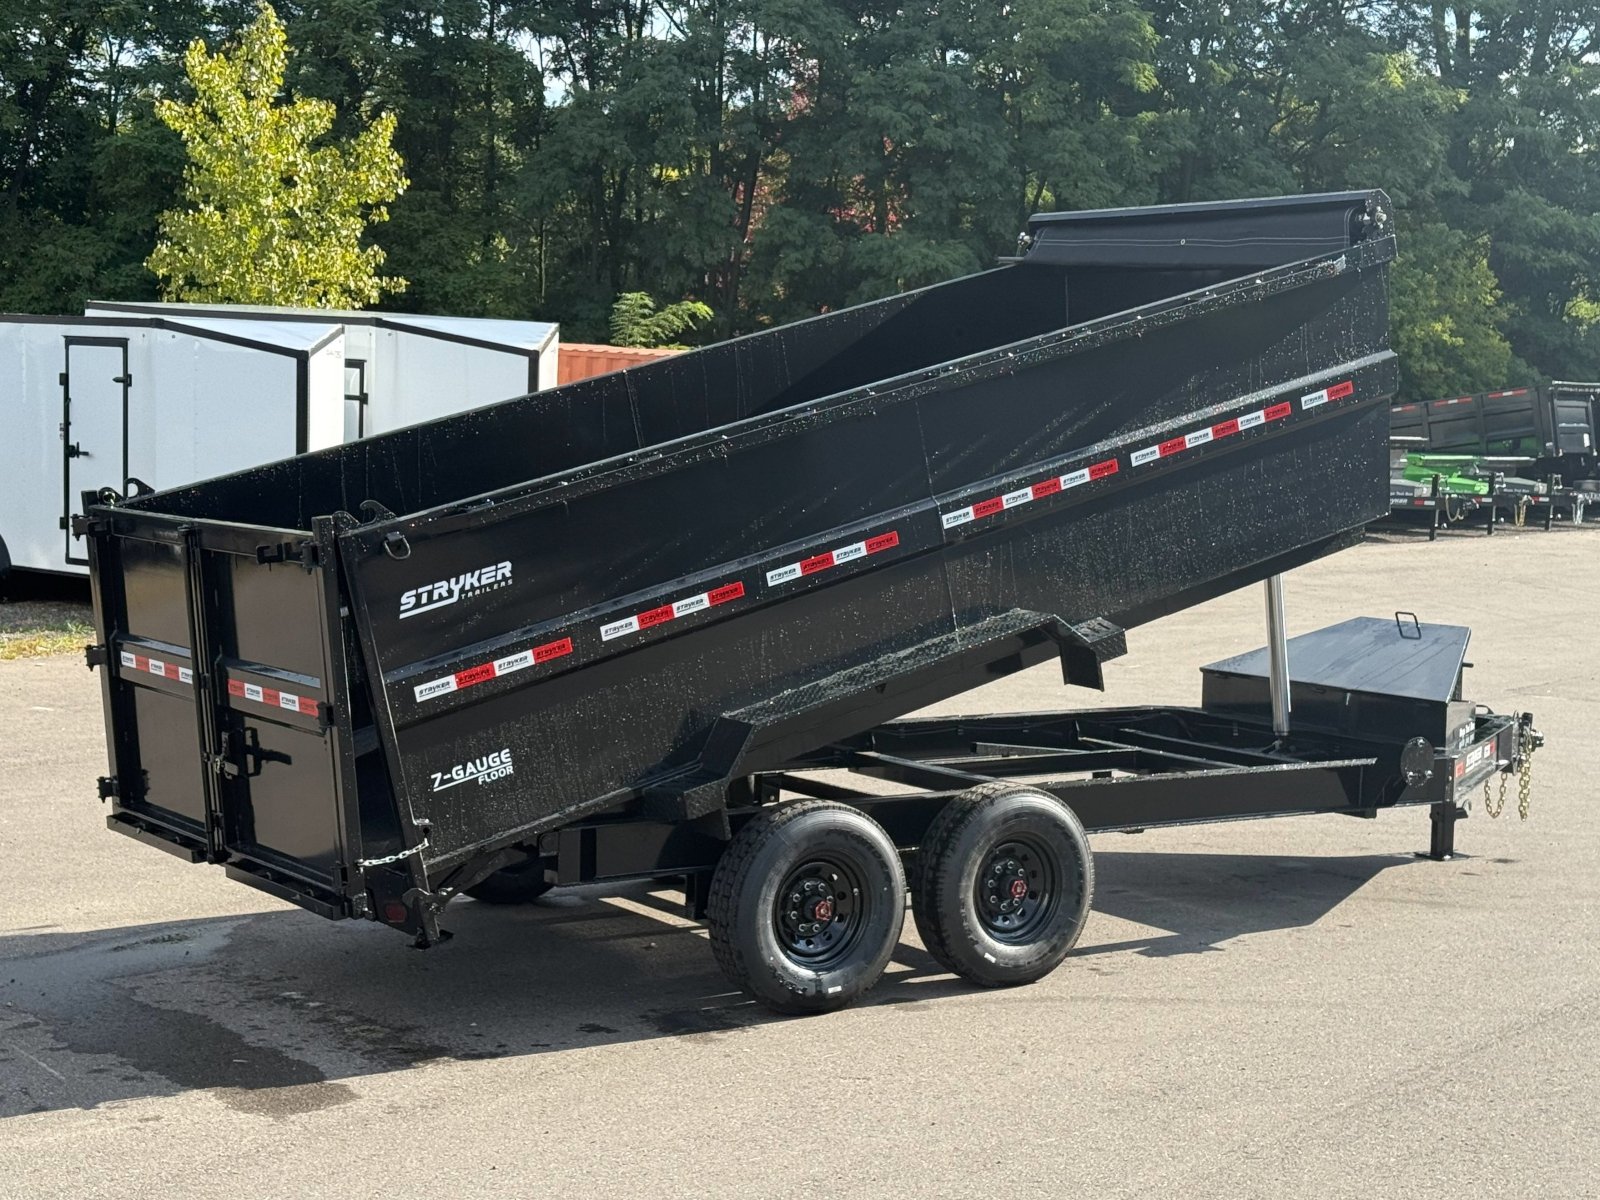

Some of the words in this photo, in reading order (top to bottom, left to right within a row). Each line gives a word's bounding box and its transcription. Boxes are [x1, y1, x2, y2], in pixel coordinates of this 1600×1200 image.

[400, 560, 513, 618] STRYKER
[461, 579, 513, 599] TRAILERS
[604, 622, 634, 636] STRYKER
[676, 599, 704, 612] STRYKER
[419, 681, 450, 697] STRYKER
[498, 656, 528, 670] STRYKER
[431, 748, 513, 789] 7-GAUGE
[478, 765, 514, 785] FLOOR
